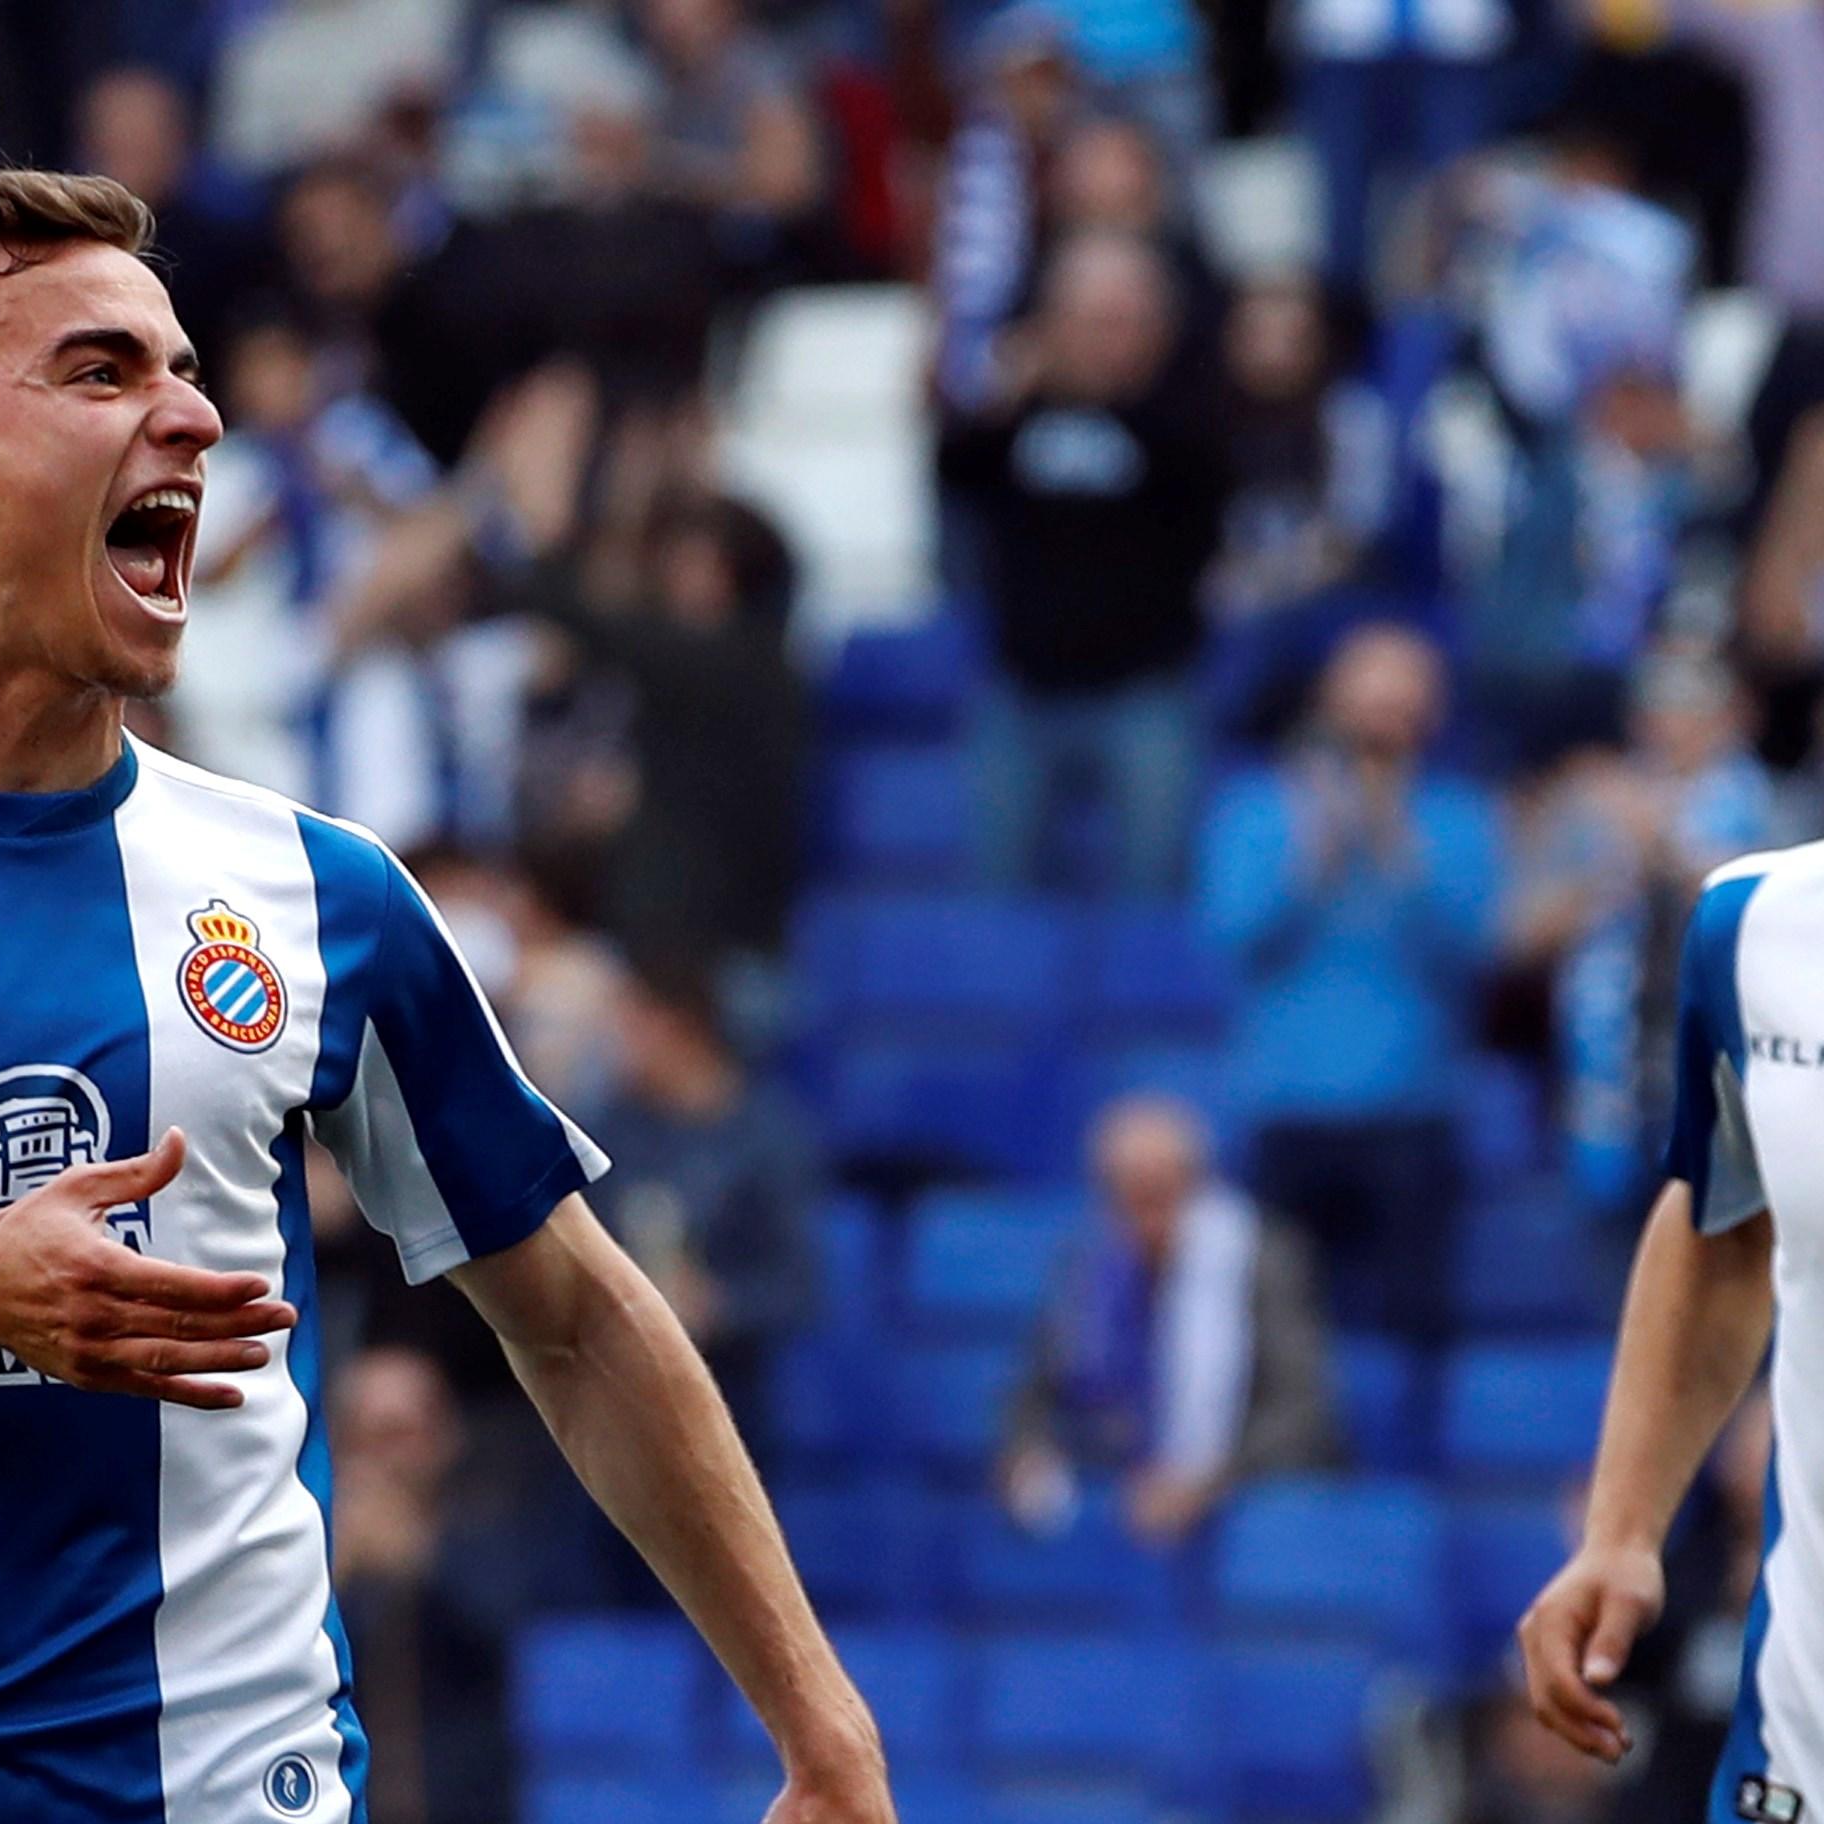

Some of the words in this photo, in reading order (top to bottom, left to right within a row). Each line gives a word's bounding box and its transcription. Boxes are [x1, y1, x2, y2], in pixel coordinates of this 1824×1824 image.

[187, 952, 210, 983] RCD
[208, 945, 277, 994] ESPANYOL
[190, 991, 210, 1012] DE
[209, 1000, 280, 1041] BARCELONA
